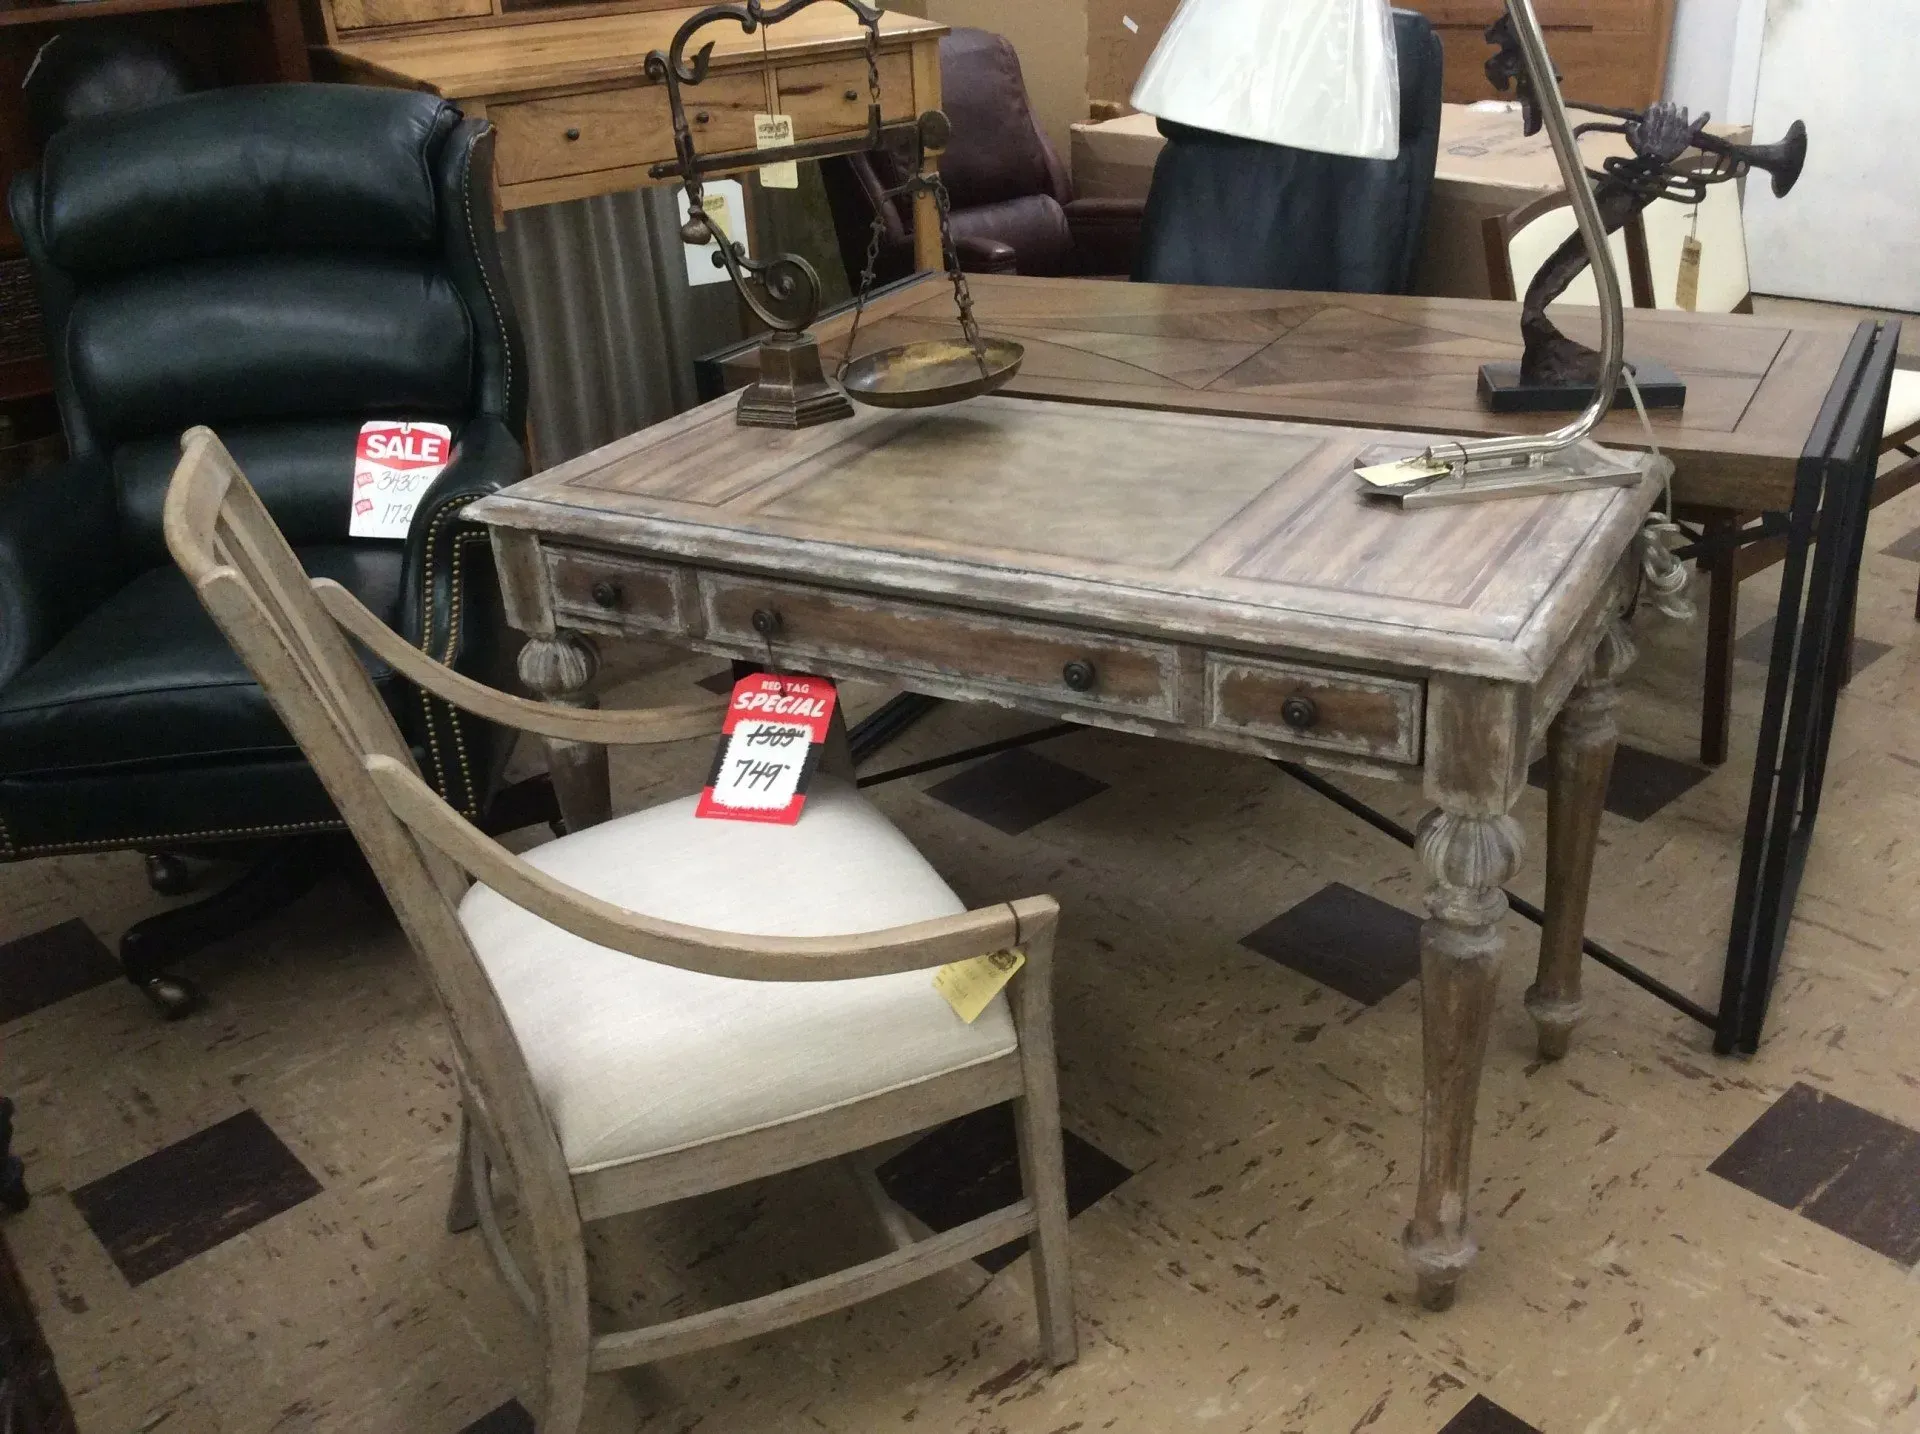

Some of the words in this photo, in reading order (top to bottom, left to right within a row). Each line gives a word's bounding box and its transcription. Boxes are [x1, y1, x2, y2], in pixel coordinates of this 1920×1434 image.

[366, 434, 441, 462] SALE
[761, 680, 782, 690] RED
[786, 682, 809, 693] TAG
[733, 692, 826, 718] SPECIAL
